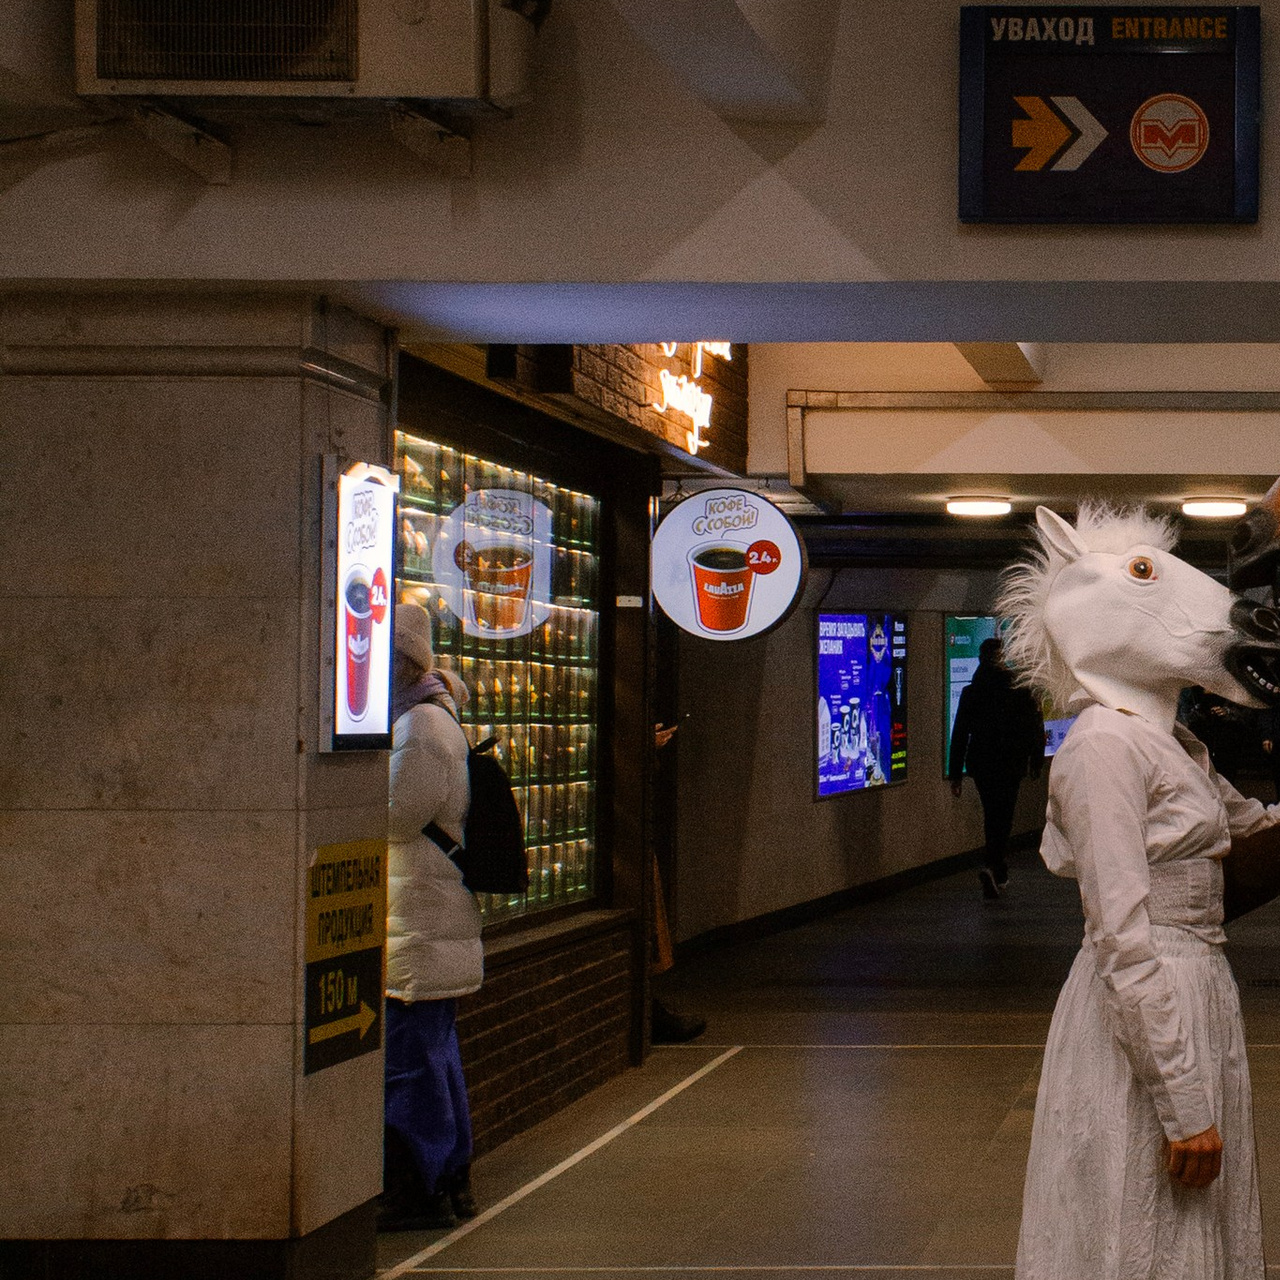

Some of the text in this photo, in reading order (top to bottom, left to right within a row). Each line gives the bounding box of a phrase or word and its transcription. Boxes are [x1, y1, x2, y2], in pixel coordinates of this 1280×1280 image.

[990, 16, 1229, 46] УВАХОД ENTRANCE
[696, 510, 755, 533] С СОБОЙ!
[708, 498, 743, 516] КОФЕ
[703, 581, 743, 595] LAVAZZA
[311, 855, 380, 898] ШТЕМПЕЛЬНАЯ
[318, 903, 374, 947] ПРОДУКЦИЯ
[318, 968, 344, 1015] 150
